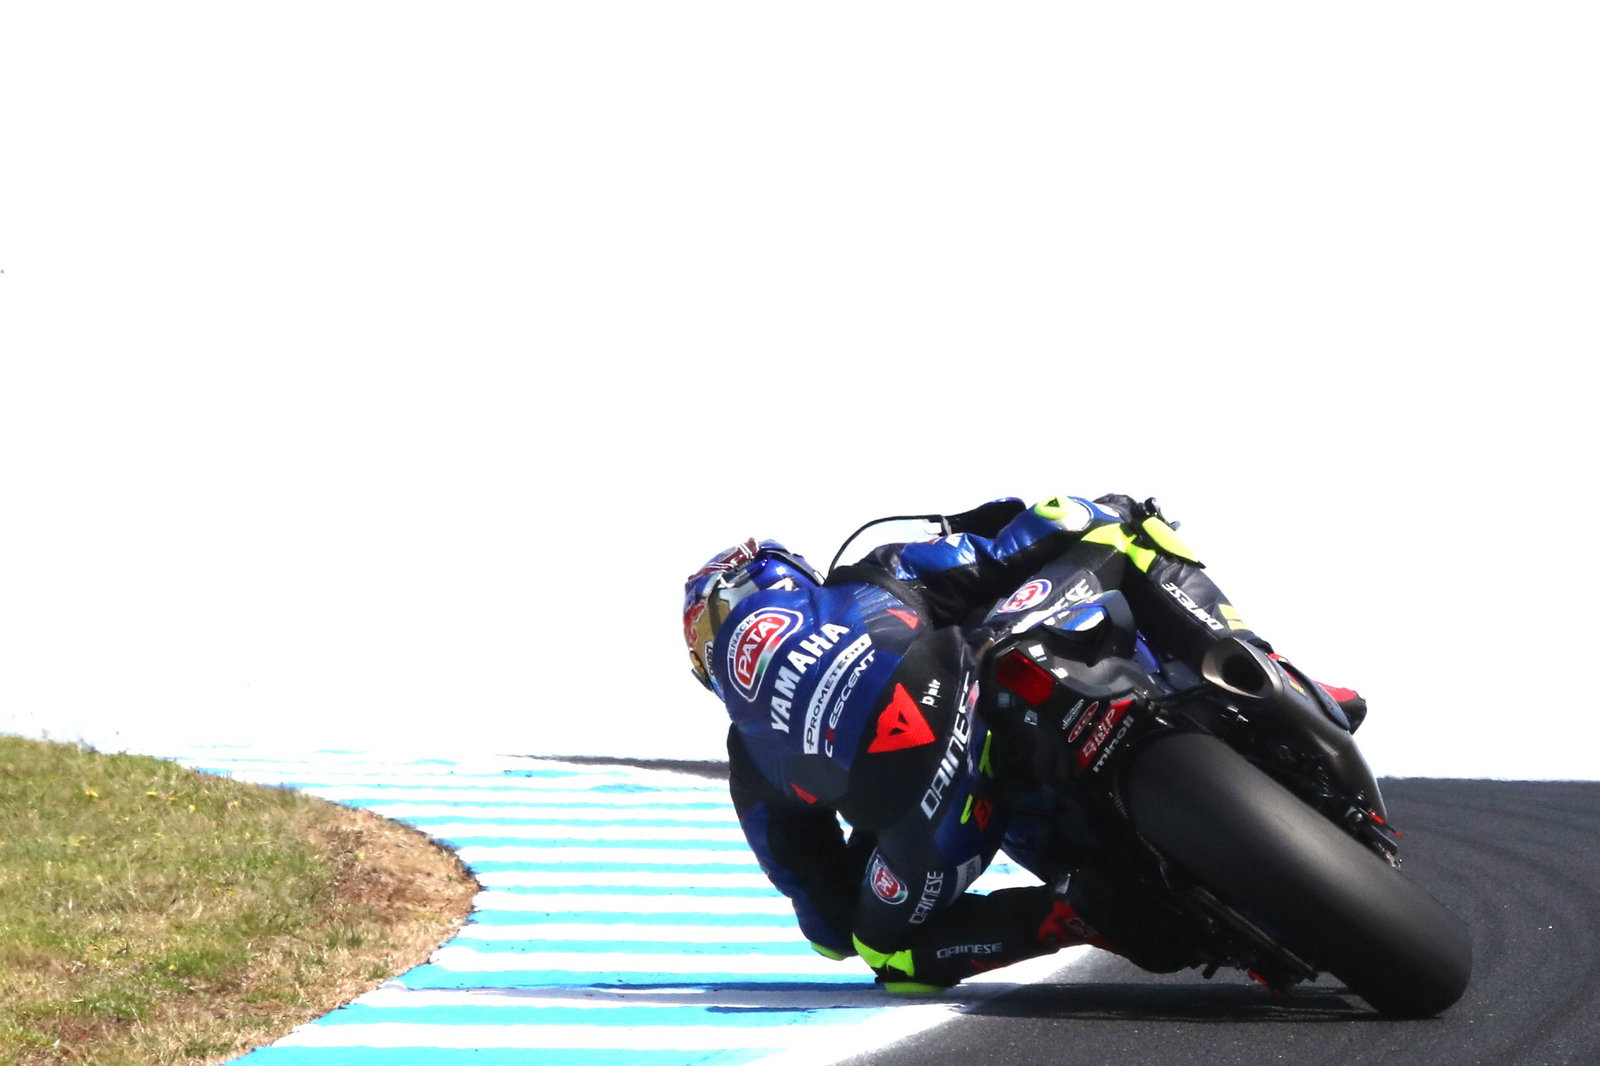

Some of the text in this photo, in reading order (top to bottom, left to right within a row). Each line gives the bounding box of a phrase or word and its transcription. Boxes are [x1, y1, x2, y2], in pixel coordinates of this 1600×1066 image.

[729, 618, 754, 659] SNACK
[737, 620, 781, 678] PATA
[771, 622, 850, 734] YAMAHA
[806, 639, 868, 748] PROMETEON
[920, 671, 970, 820] DAINES
[908, 871, 944, 924] DAINESE
[936, 942, 1003, 959] DAINESE
